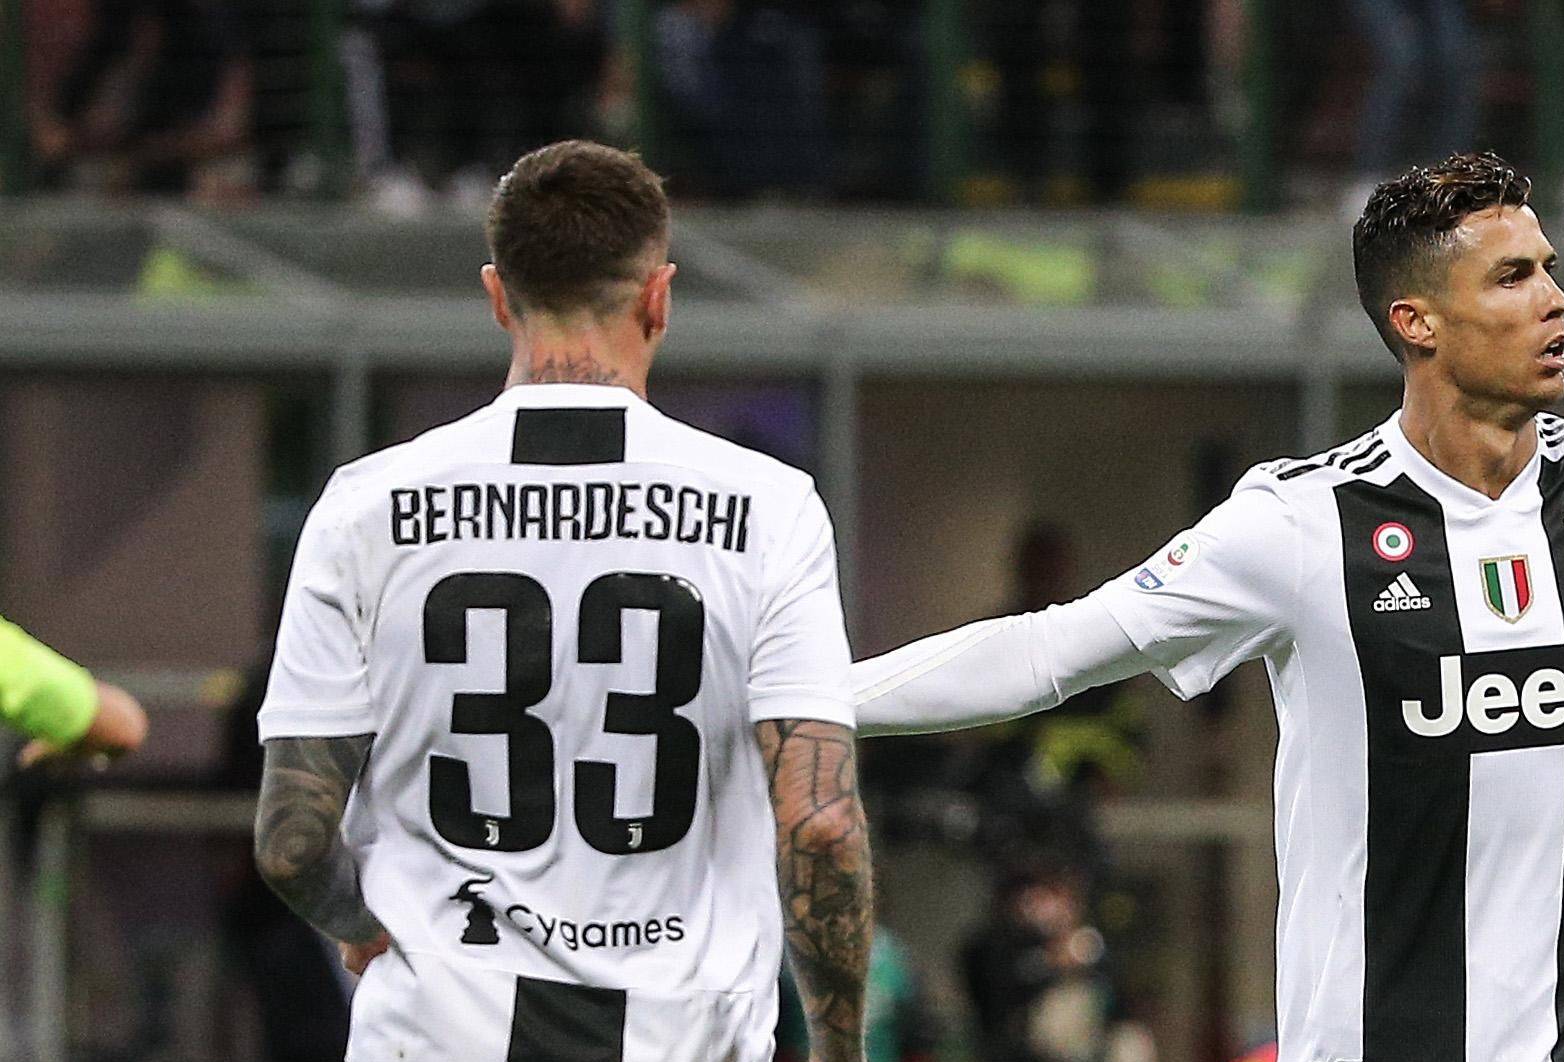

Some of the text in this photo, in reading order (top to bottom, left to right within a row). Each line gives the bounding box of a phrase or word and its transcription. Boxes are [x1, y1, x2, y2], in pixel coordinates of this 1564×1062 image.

[390, 482, 751, 553] BERNARDESCHI
[1373, 595, 1432, 612] adidas
[422, 569, 705, 857] 33
